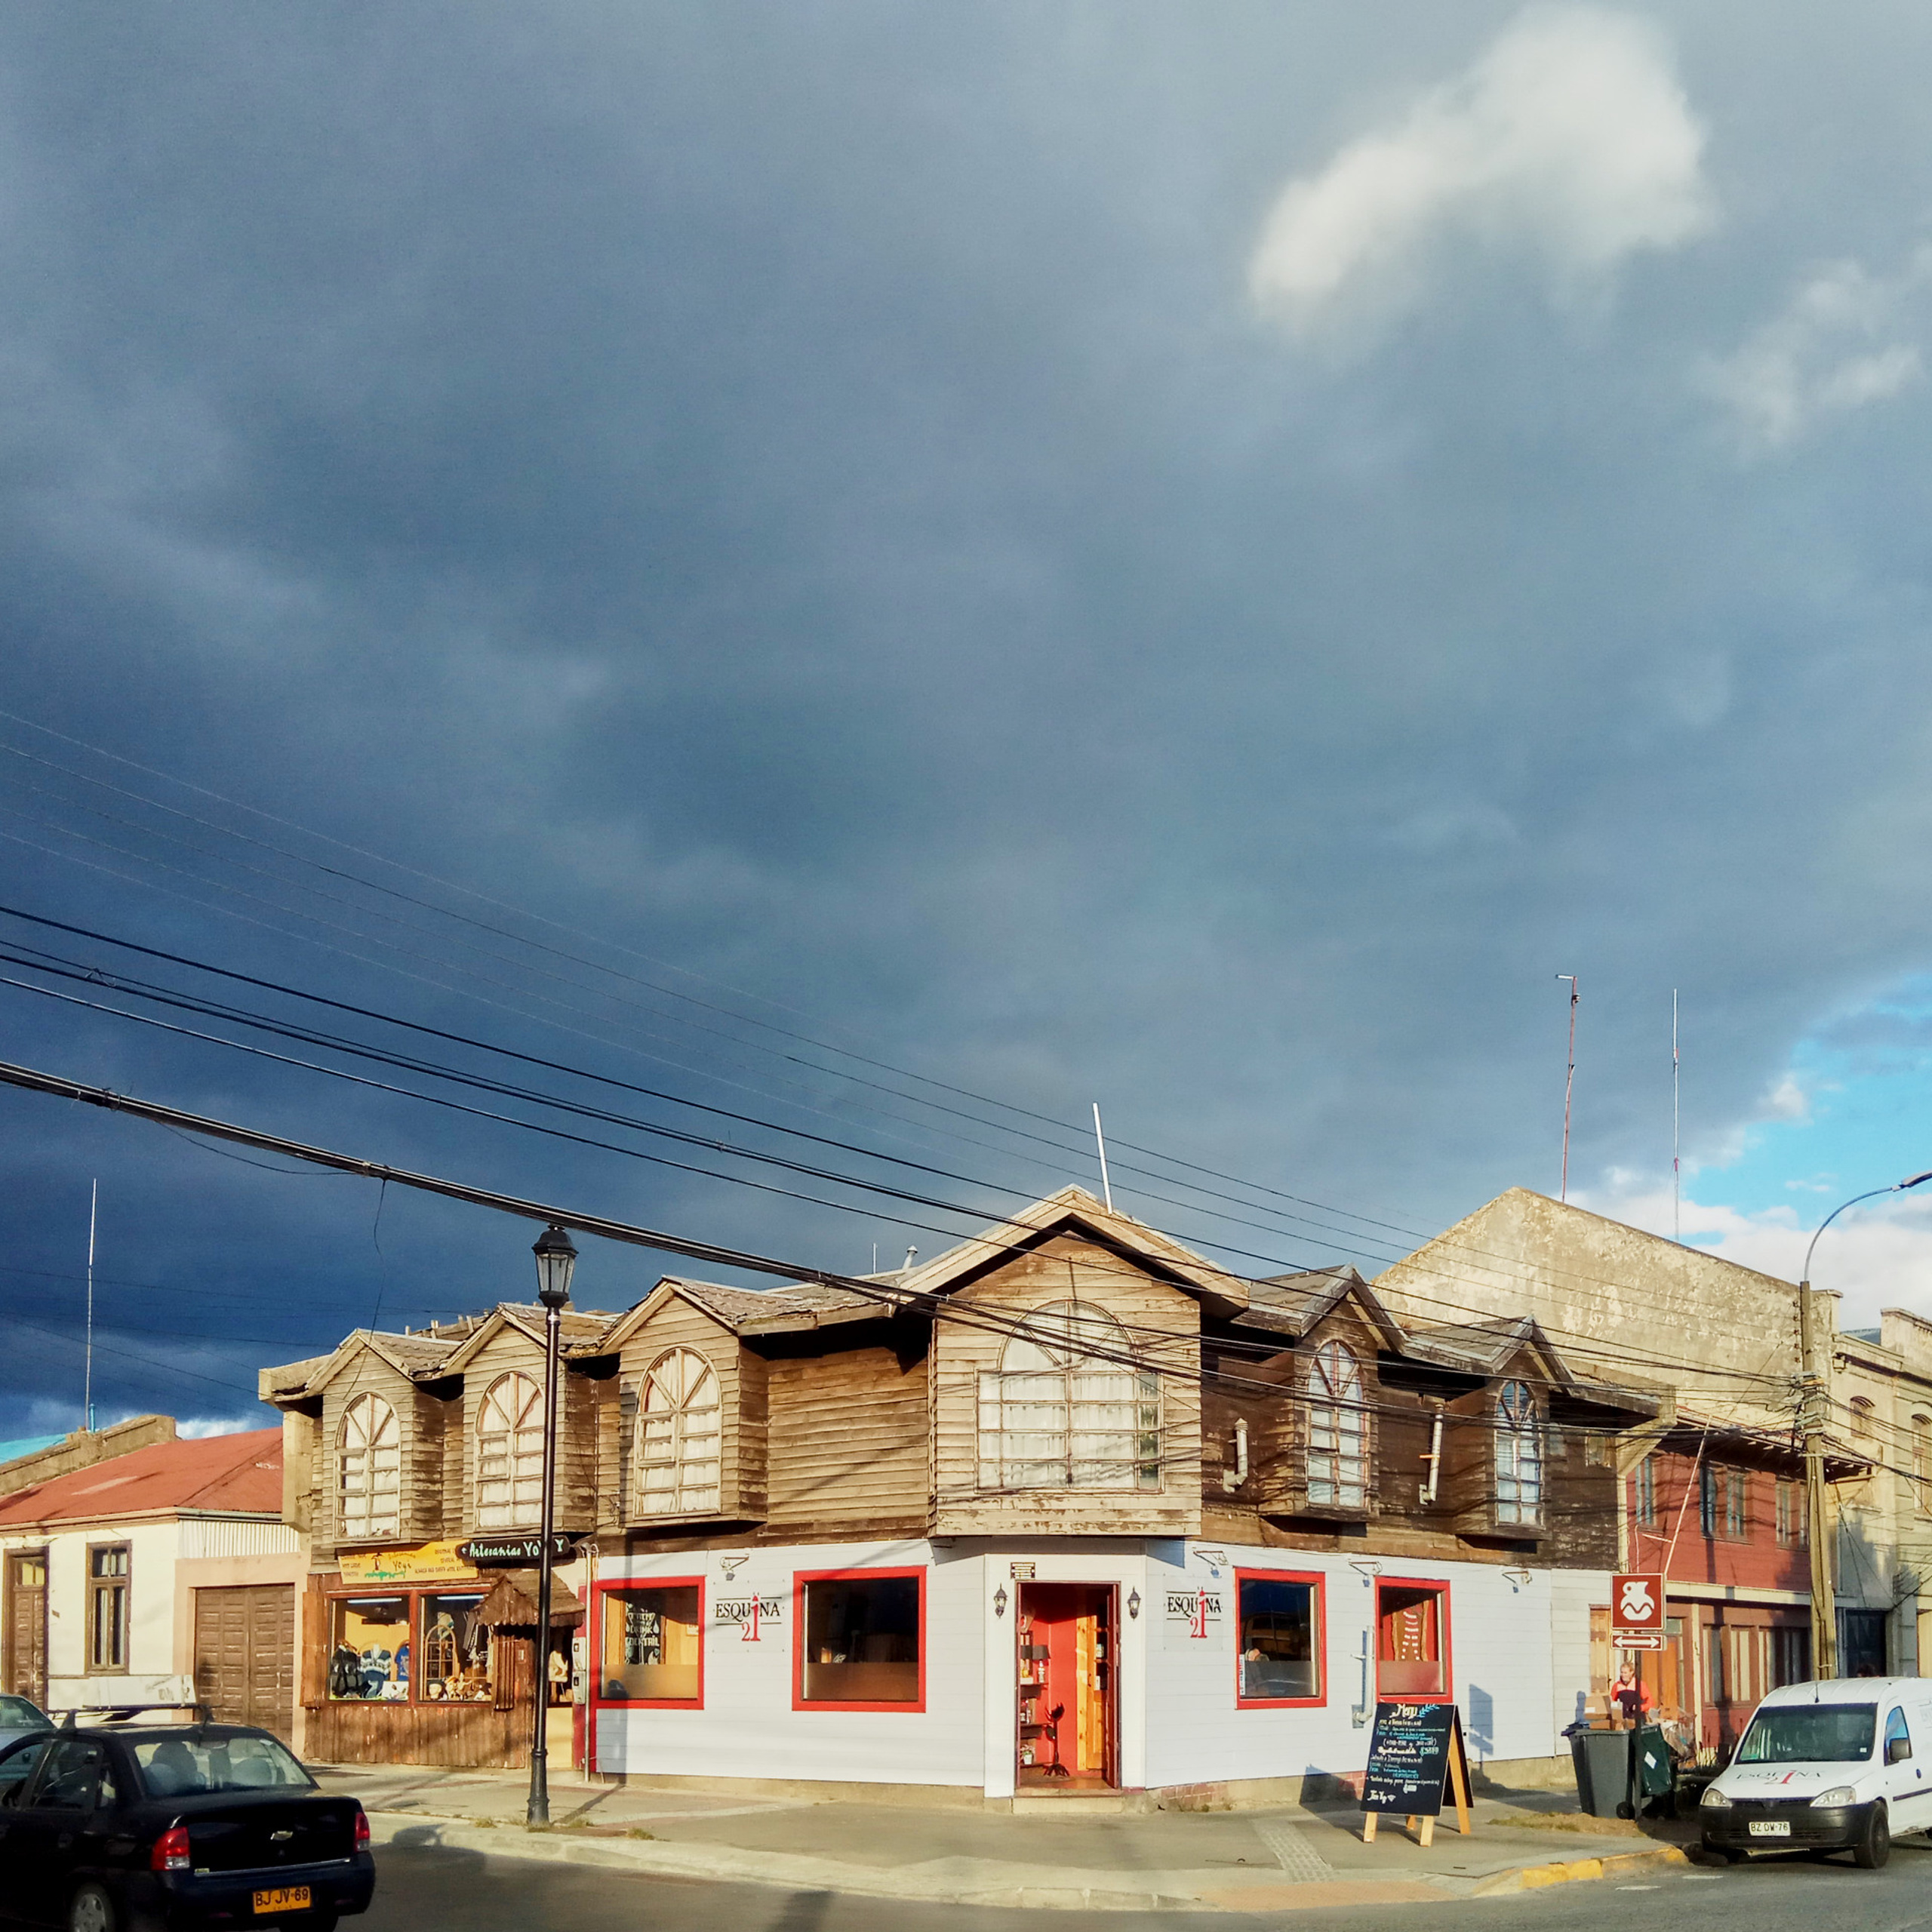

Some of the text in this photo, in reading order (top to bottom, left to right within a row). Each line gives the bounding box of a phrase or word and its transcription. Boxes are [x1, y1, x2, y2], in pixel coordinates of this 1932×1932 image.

[469, 1542, 521, 1558] Artesanias
[715, 1601, 781, 1623] ESQUINA
[1168, 1595, 1222, 1618] ESQUINA
[741, 1601, 761, 1641] 21
[1189, 1598, 1208, 1638] 21
[1751, 1823, 1761, 1832] BZ
[256, 1891, 271, 1906] BJ
